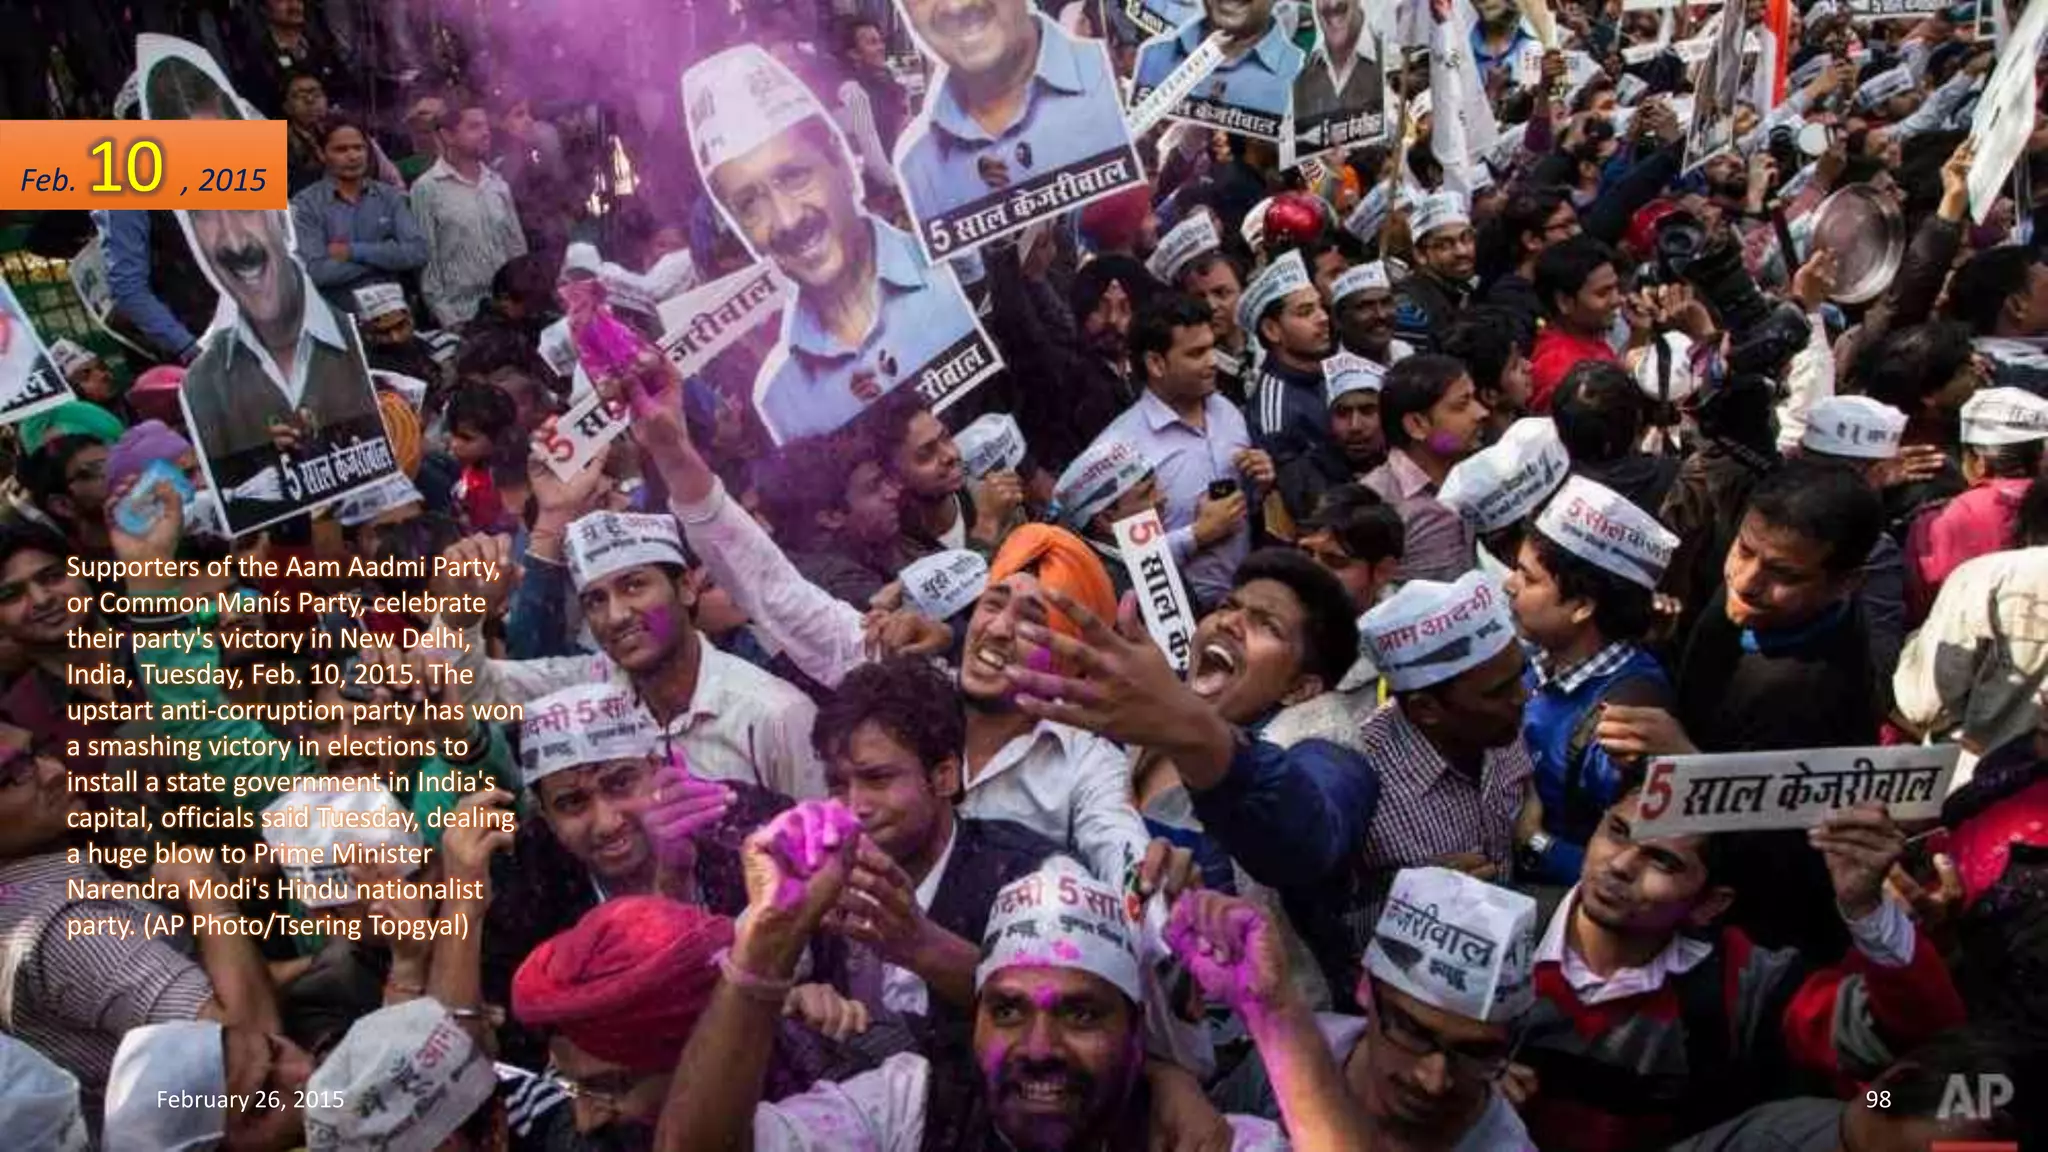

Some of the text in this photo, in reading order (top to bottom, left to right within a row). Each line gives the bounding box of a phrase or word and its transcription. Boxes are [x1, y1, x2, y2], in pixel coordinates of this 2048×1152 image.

[929, 158, 1129, 252] 5 साल केजरीवाल
[663, 270, 778, 362] जरीवाल
[279, 452, 302, 501] 5
[1129, 519, 1160, 546] 5
[1140, 551, 1181, 624] साल
[577, 698, 596, 724] 5
[1639, 757, 1943, 821] 5 साल केजरीवाल
[1058, 875, 1079, 905] 5
